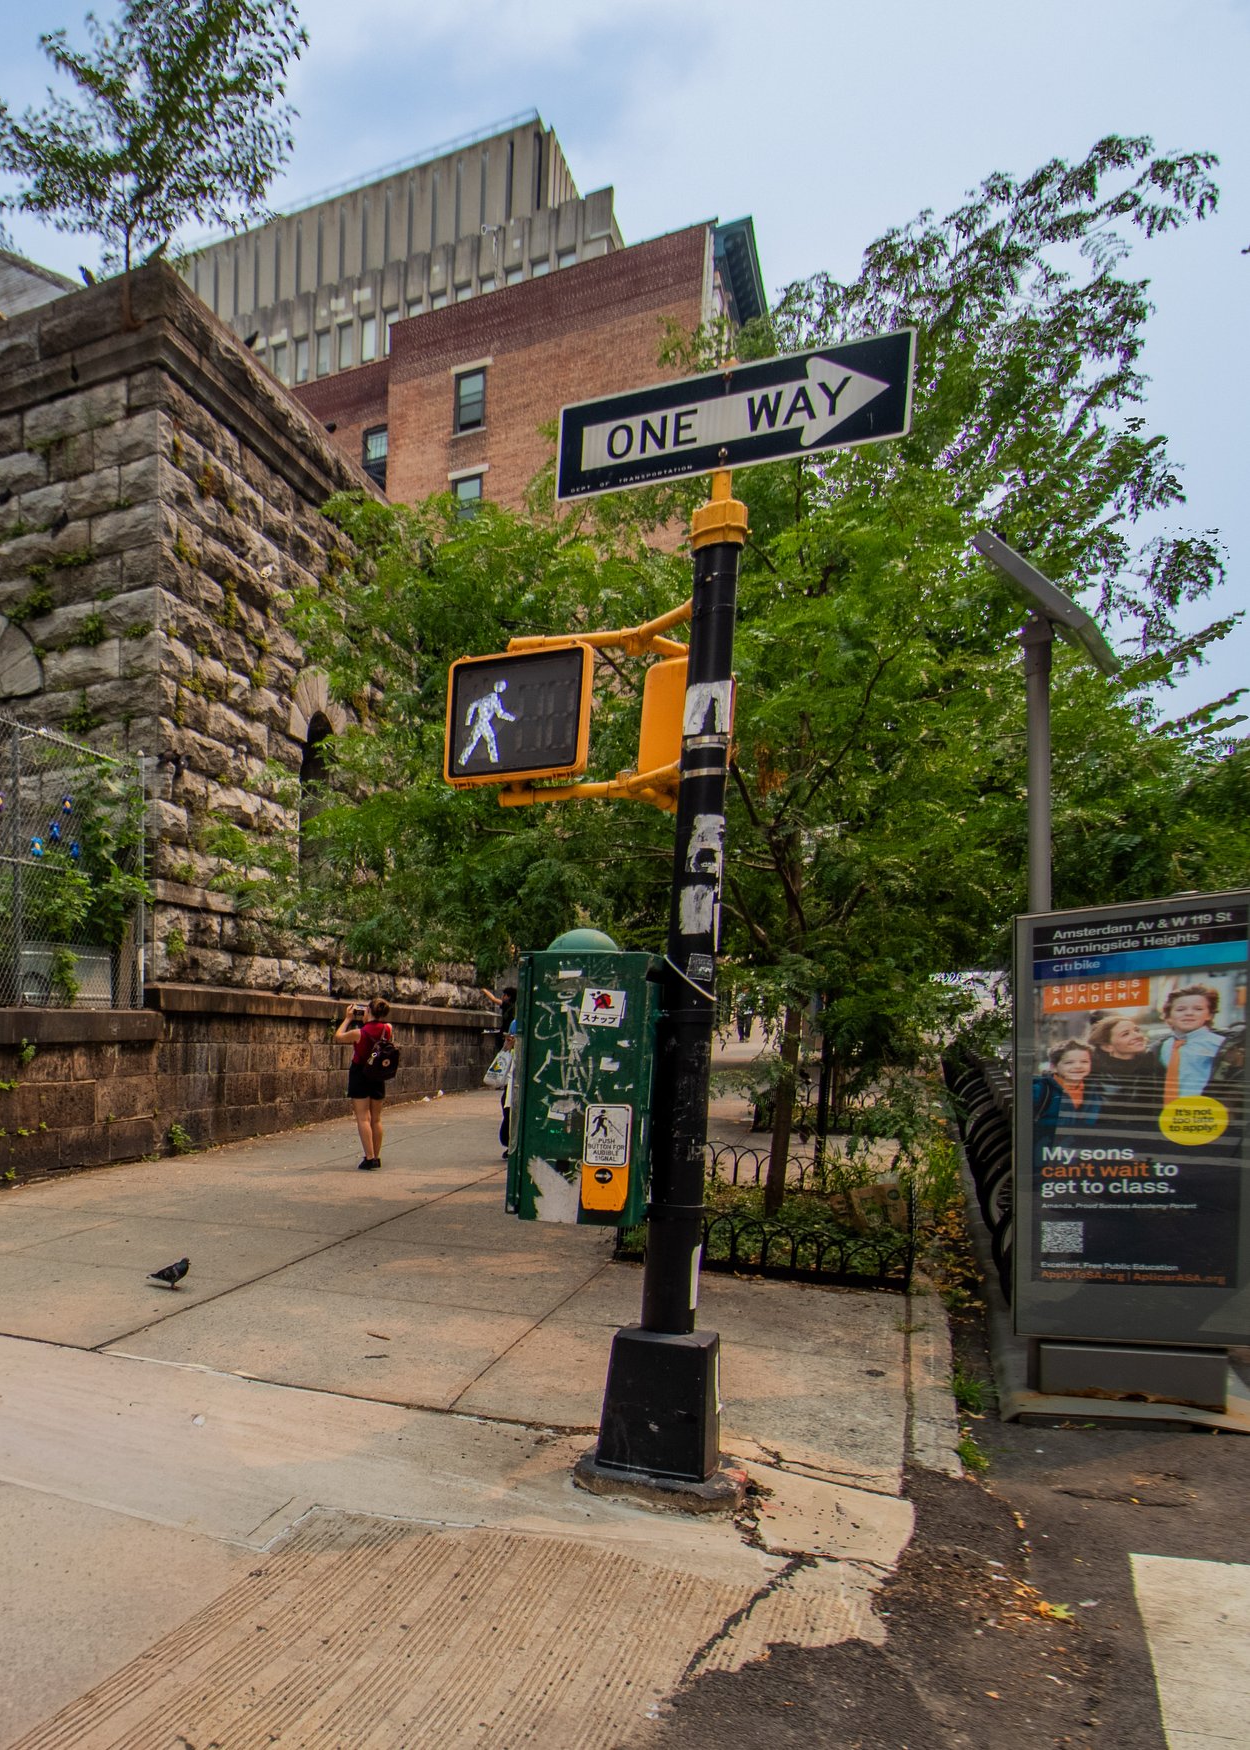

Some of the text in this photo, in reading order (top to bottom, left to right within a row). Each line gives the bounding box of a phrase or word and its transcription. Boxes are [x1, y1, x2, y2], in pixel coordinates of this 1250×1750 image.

[606, 376, 852, 459] ONE WAY
[570, 485, 590, 494] DEPT
[619, 464, 693, 483] TRANSPORTATION
[1052, 912, 1232, 940] Amsterdam Av & W 119 St
[1053, 932, 1200, 956] Morningside Heights
[1052, 979, 1140, 994] SUCCESS
[1052, 991, 1140, 1006] ACADEMY
[1193, 1108, 1212, 1116] not
[1193, 1115, 1215, 1123] late
[1169, 1124, 1181, 1132] to
[593, 1149, 619, 1157] AUDIBLE
[1042, 1146, 1134, 1165] My sons
[1041, 1162, 1179, 1178] can't wait to
[1041, 1178, 1176, 1198] get to class.
[1132, 1202, 1168, 1211] Academy
[1083, 1261, 1102, 1269] Free
[1103, 1262, 1133, 1270] Public
[1133, 1263, 1179, 1271] Education
[1041, 1269, 1126, 1282] ApplyToSA.org
